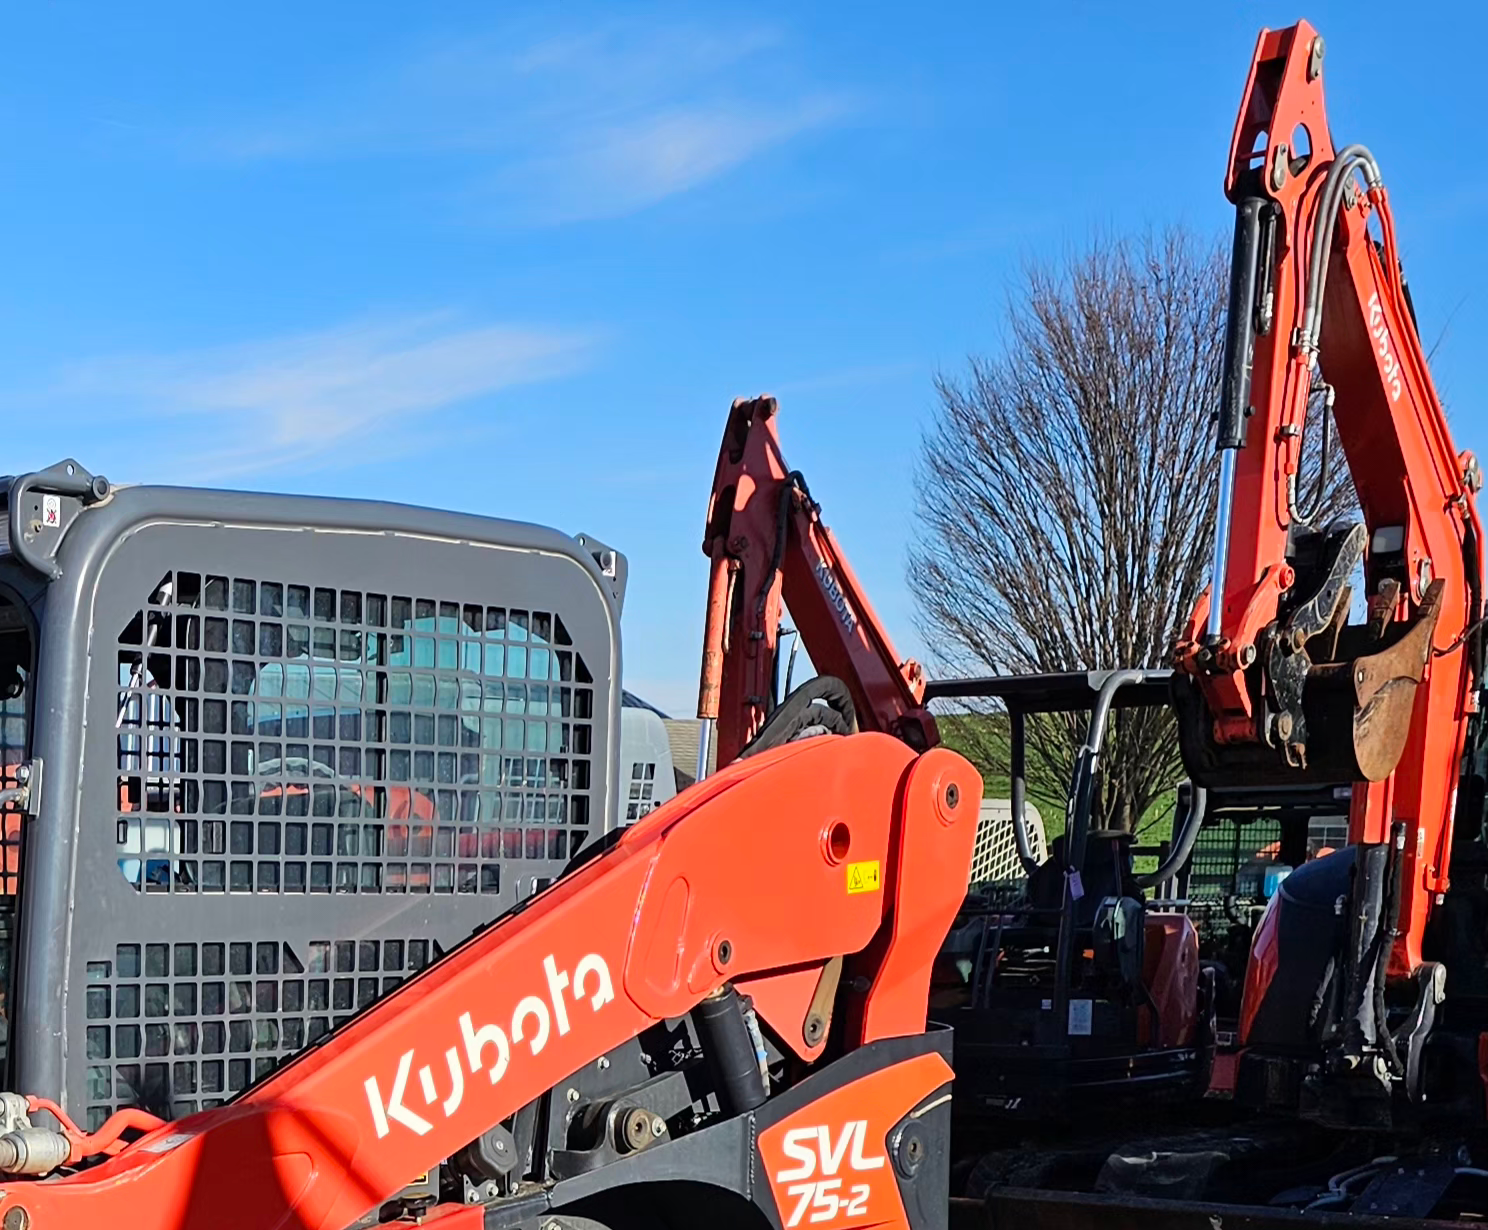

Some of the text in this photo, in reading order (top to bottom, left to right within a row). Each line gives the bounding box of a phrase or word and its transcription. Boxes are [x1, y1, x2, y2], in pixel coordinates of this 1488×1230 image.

[1368, 291, 1402, 402] Kubota
[815, 560, 855, 633] KUBOTA
[364, 953, 615, 1139] Kubota
[776, 1119, 885, 1184] SVL
[786, 1178, 871, 1228] 75-2
